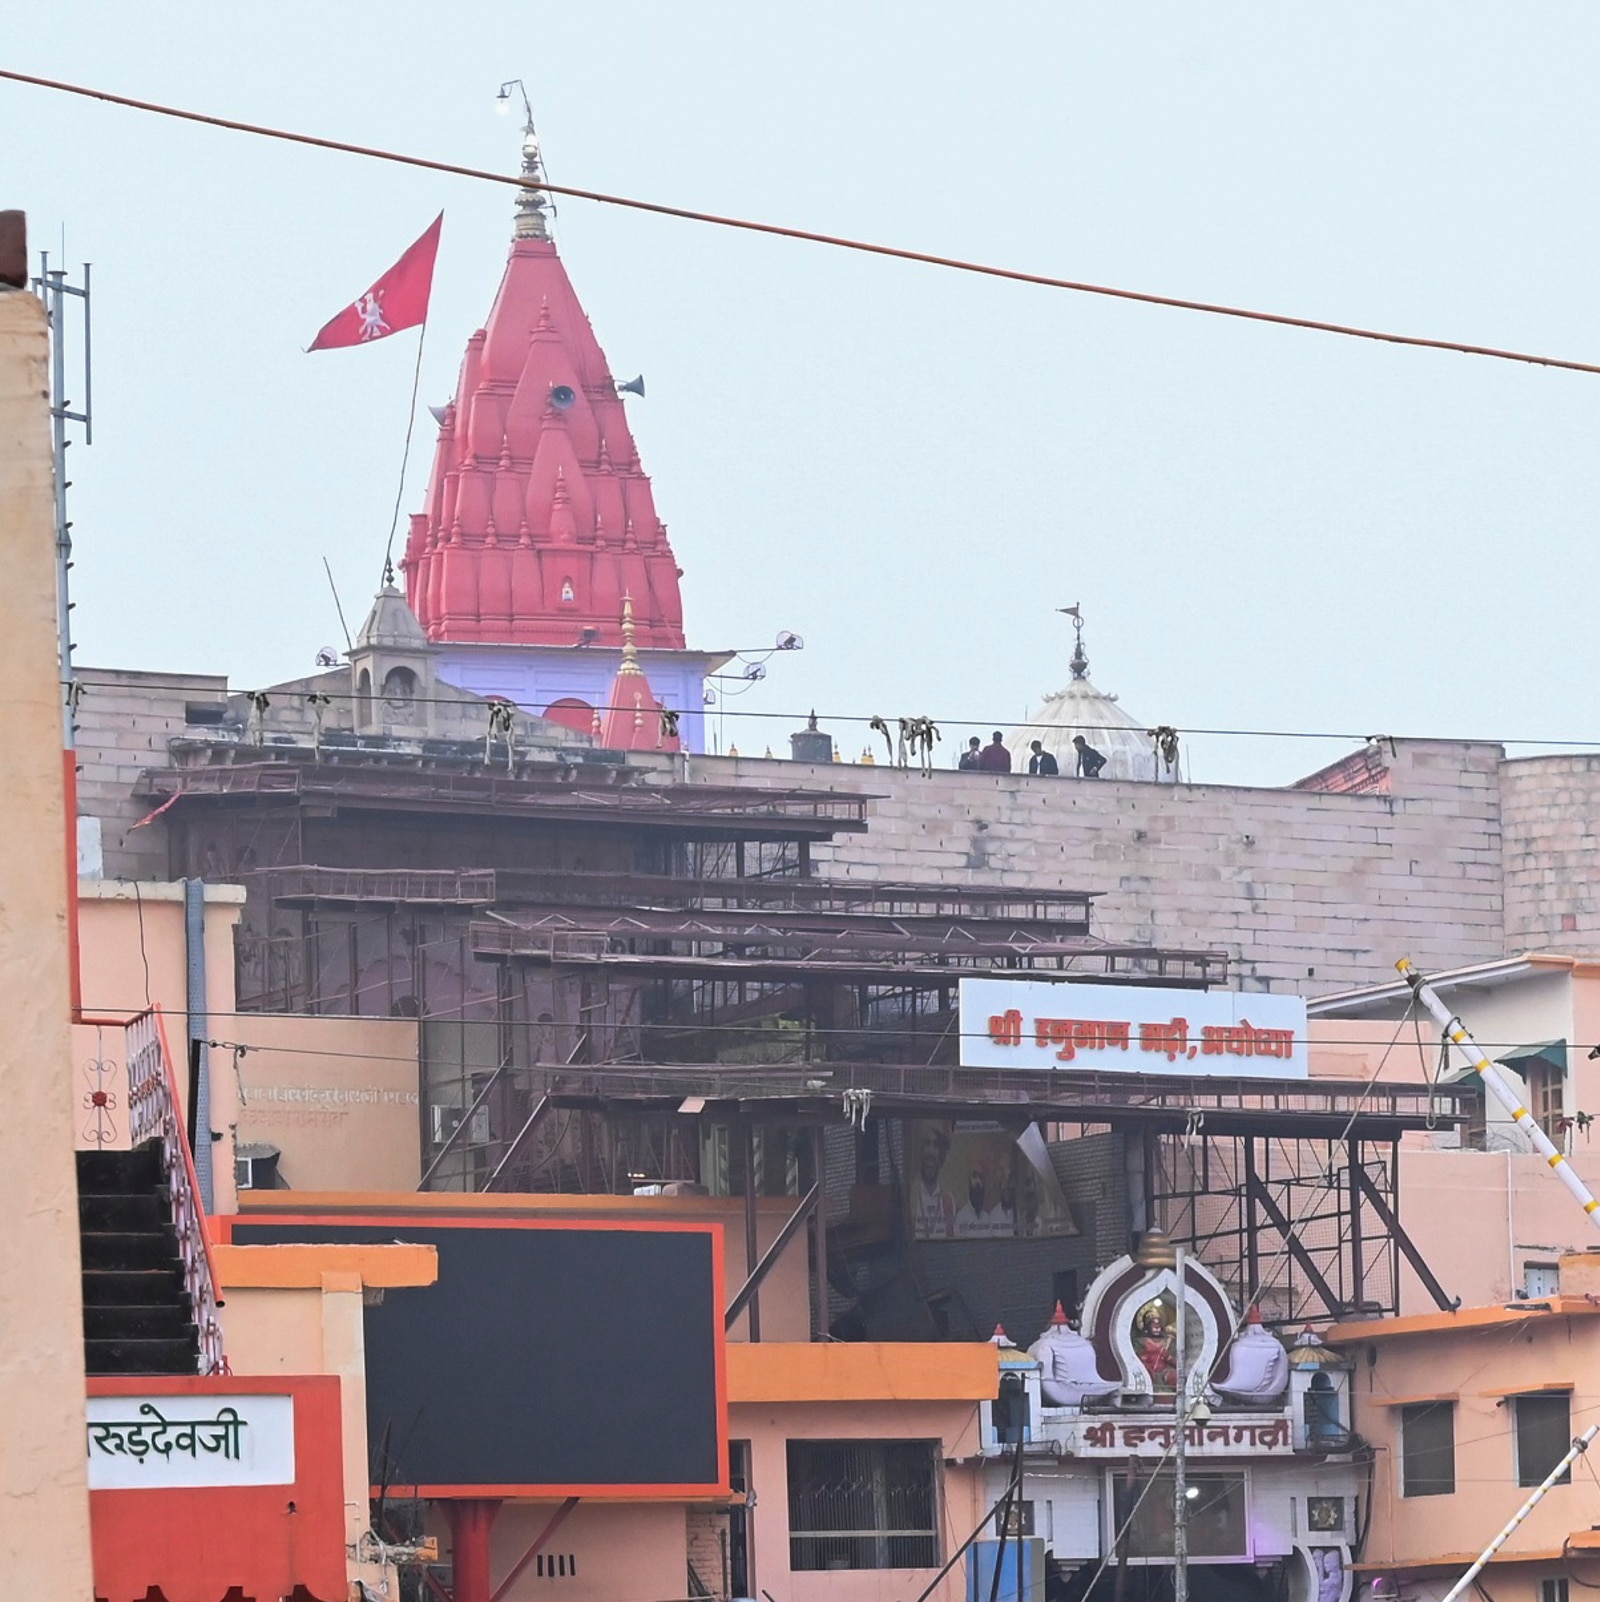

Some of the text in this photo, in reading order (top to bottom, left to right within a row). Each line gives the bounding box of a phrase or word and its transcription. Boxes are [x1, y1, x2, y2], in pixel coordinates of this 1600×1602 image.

[988, 1009, 1023, 1046] श्री
[1034, 1017, 1131, 1061] हनुमान
[1083, 1421, 1117, 1448] श्री
